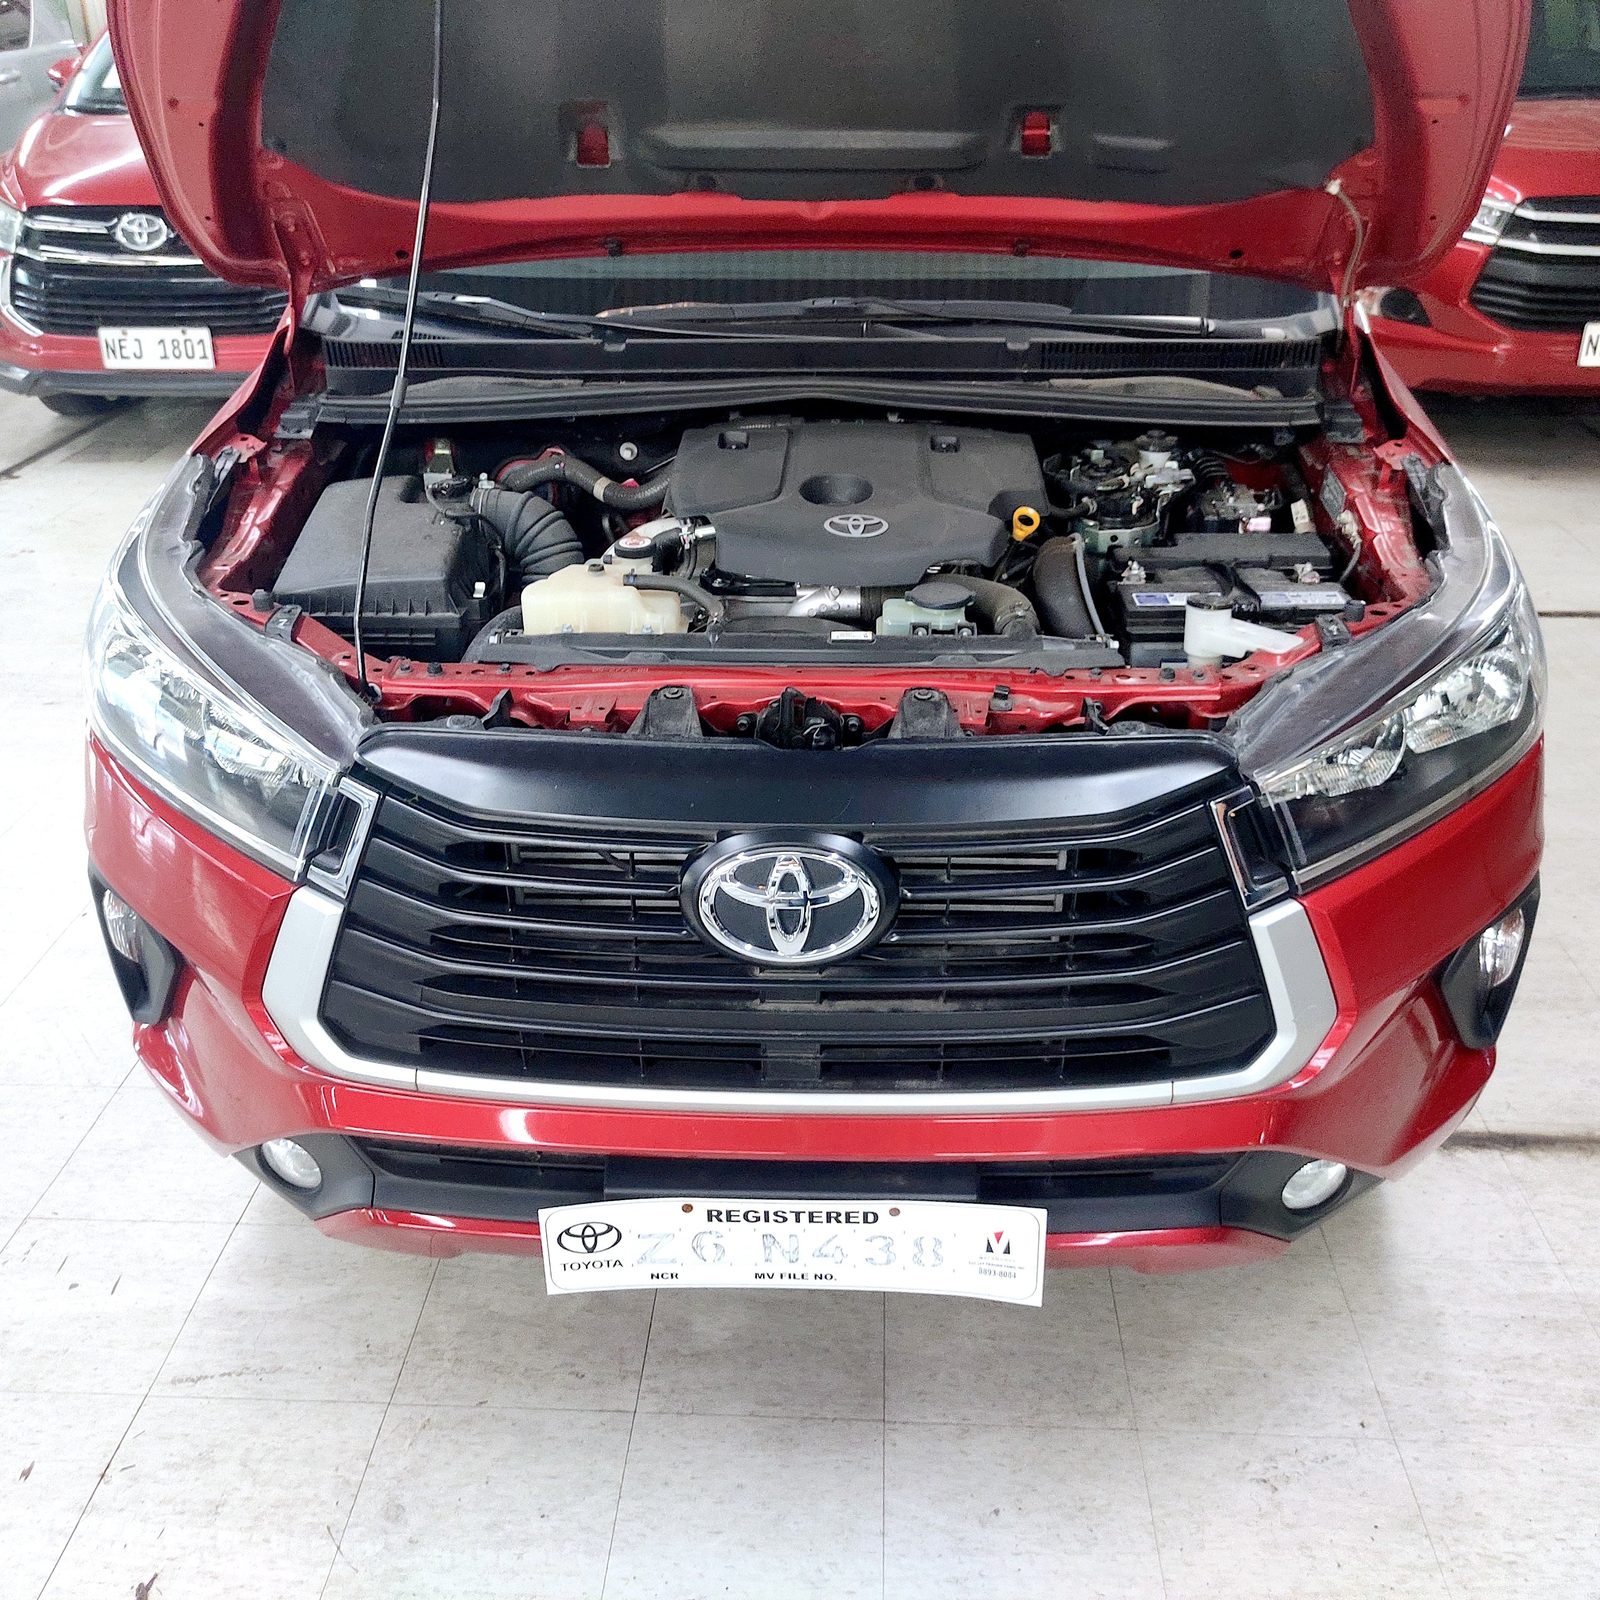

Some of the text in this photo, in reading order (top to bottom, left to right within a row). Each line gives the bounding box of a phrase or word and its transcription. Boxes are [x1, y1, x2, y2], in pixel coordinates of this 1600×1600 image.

[104, 338, 209, 360] NEJ 1801
[706, 1208, 880, 1225] REGISTERED
[560, 1258, 624, 1272] TOYOTA
[650, 1271, 680, 1280] NCR
[754, 1272, 838, 1281] MV FILE NO.
